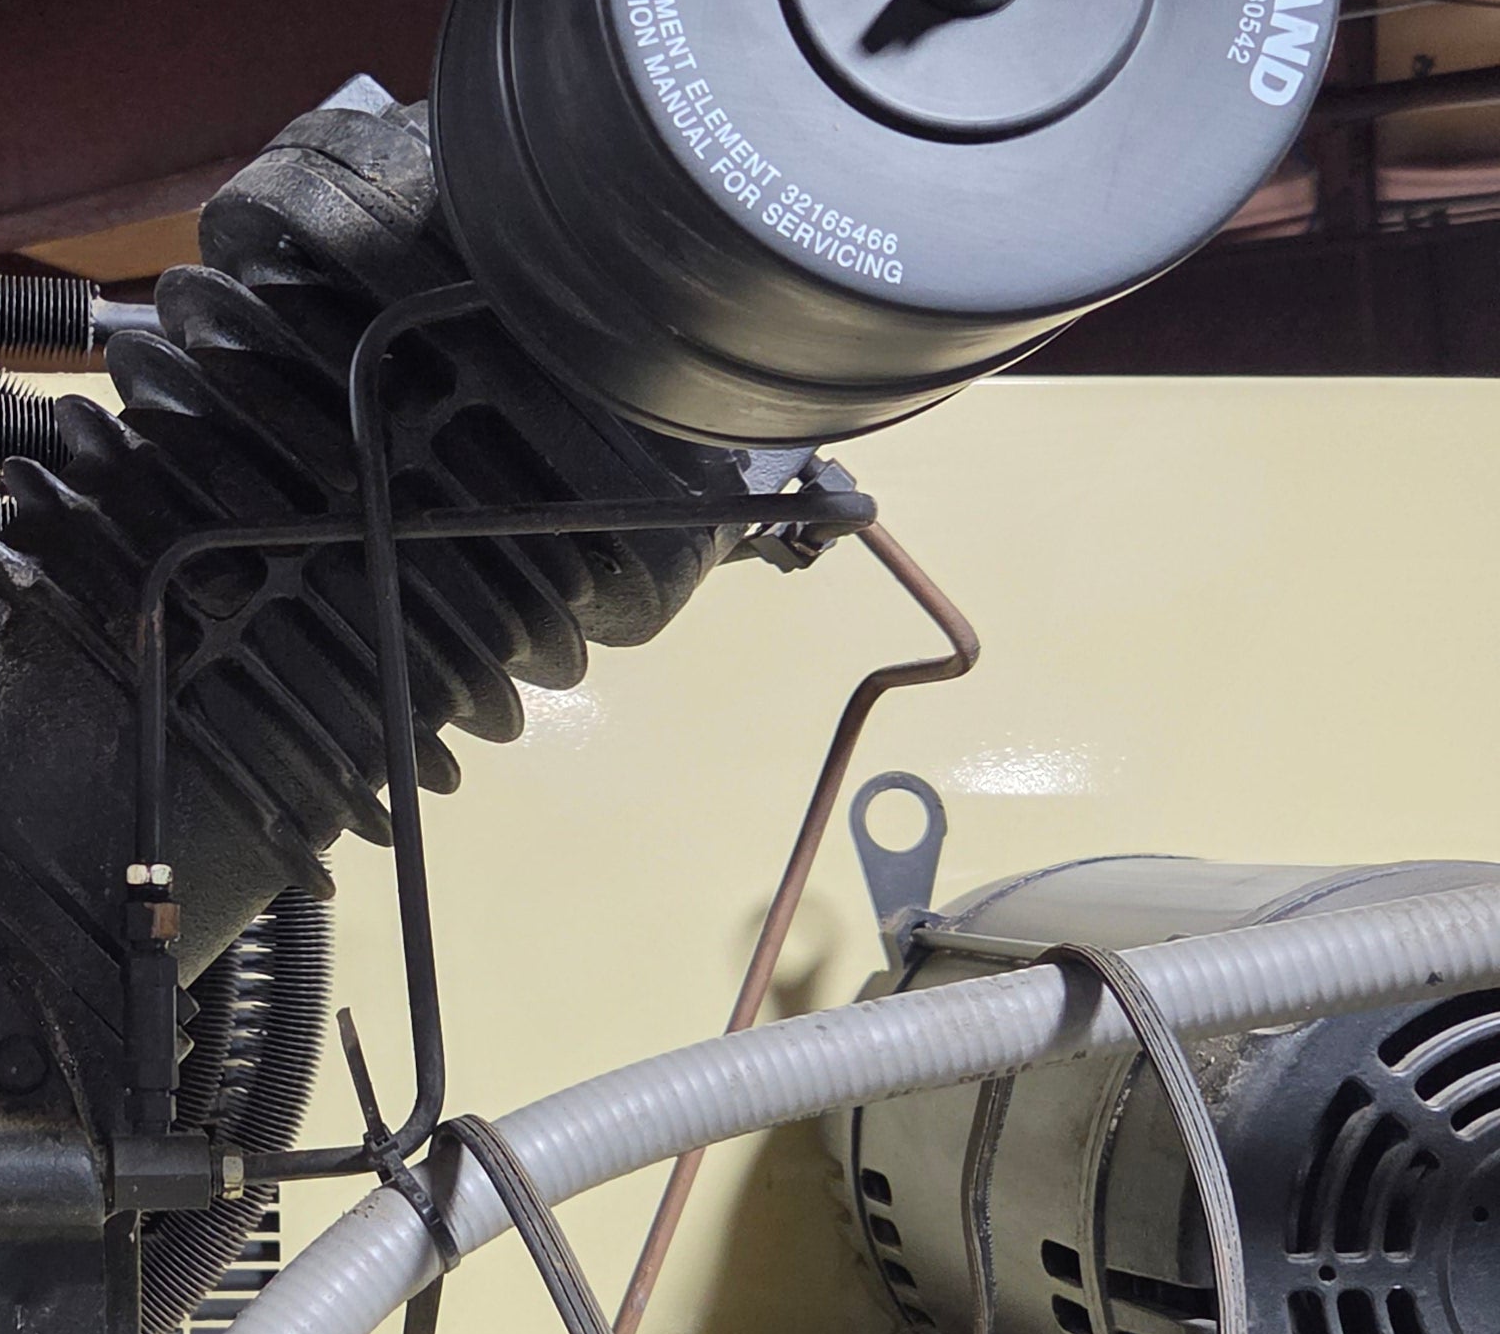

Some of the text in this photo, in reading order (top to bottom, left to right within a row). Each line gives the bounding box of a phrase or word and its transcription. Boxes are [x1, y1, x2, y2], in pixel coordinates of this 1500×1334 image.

[643, 55, 711, 160] MANUAL
[710, 161, 762, 209] FOR
[762, 203, 903, 284] SERVICING
[684, 78, 781, 187] ELEMENT
[781, 184, 897, 255] 32165466
